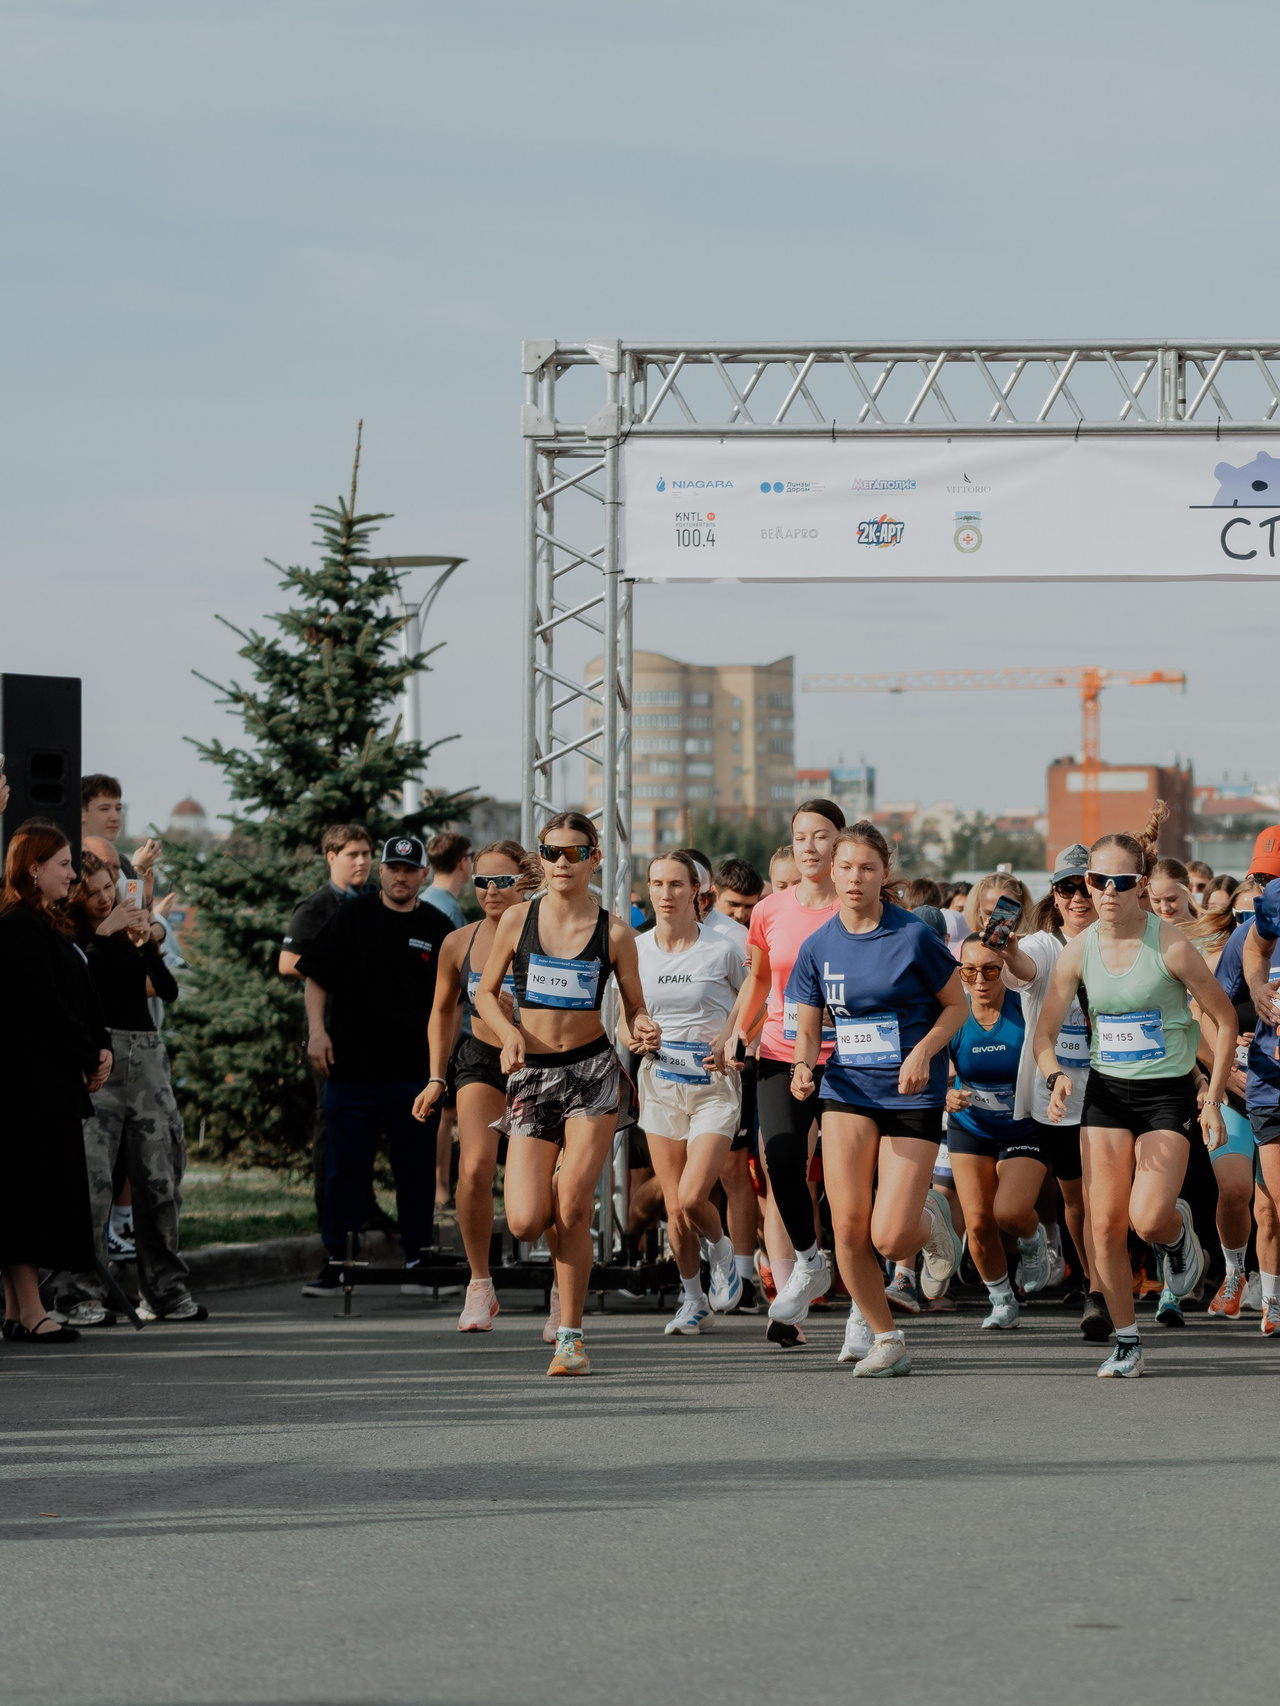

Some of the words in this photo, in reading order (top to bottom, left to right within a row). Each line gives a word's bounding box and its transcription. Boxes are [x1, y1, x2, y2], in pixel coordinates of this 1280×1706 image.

[672, 480, 733, 489] NIAGARA
[852, 478, 917, 491] МЕГАПОЛИС
[946, 486, 991, 494] VITTORIO
[675, 511, 703, 522] KNTL
[675, 528, 716, 548] 100.4
[550, 977, 568, 988] 179
[658, 974, 692, 984] КРАНК
[854, 1033, 872, 1044] 328
[1116, 1032, 1134, 1042] 155
[971, 1044, 1007, 1054] GIVOVA
[1061, 1041, 1080, 1051] 088
[670, 1057, 686, 1067] 285
[974, 1095, 990, 1104] 041
[1006, 1145, 1041, 1153] GIVOVA
